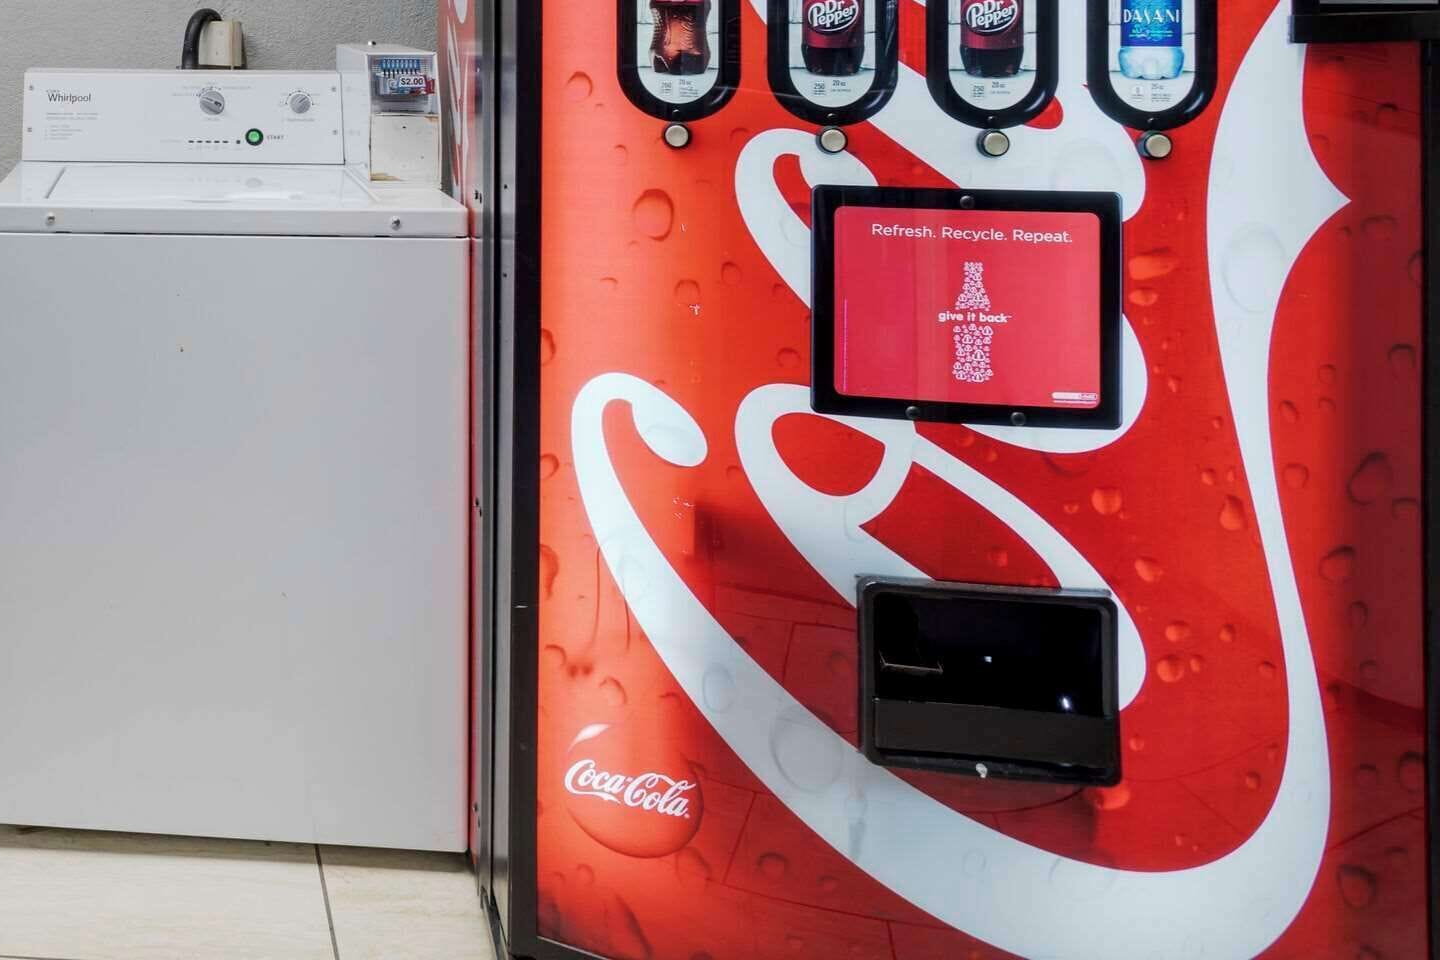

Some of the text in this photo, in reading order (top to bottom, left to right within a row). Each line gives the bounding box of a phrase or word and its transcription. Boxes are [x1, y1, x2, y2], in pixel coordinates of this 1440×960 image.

[811, 3, 856, 27] Pepper
[824, 0, 845, 15] Dr
[969, 3, 1016, 29] Pepper
[984, 0, 1004, 16] Dr
[1123, 7, 1180, 25] DASANI
[400, 77, 424, 86] $2.00
[47, 93, 92, 104] Whirlpool
[871, 223, 1073, 244] Refresh. Recycle. Repeat.
[938, 312, 964, 324] give
[967, 311, 976, 322] it
[564, 759, 696, 818] Coca-Cola
